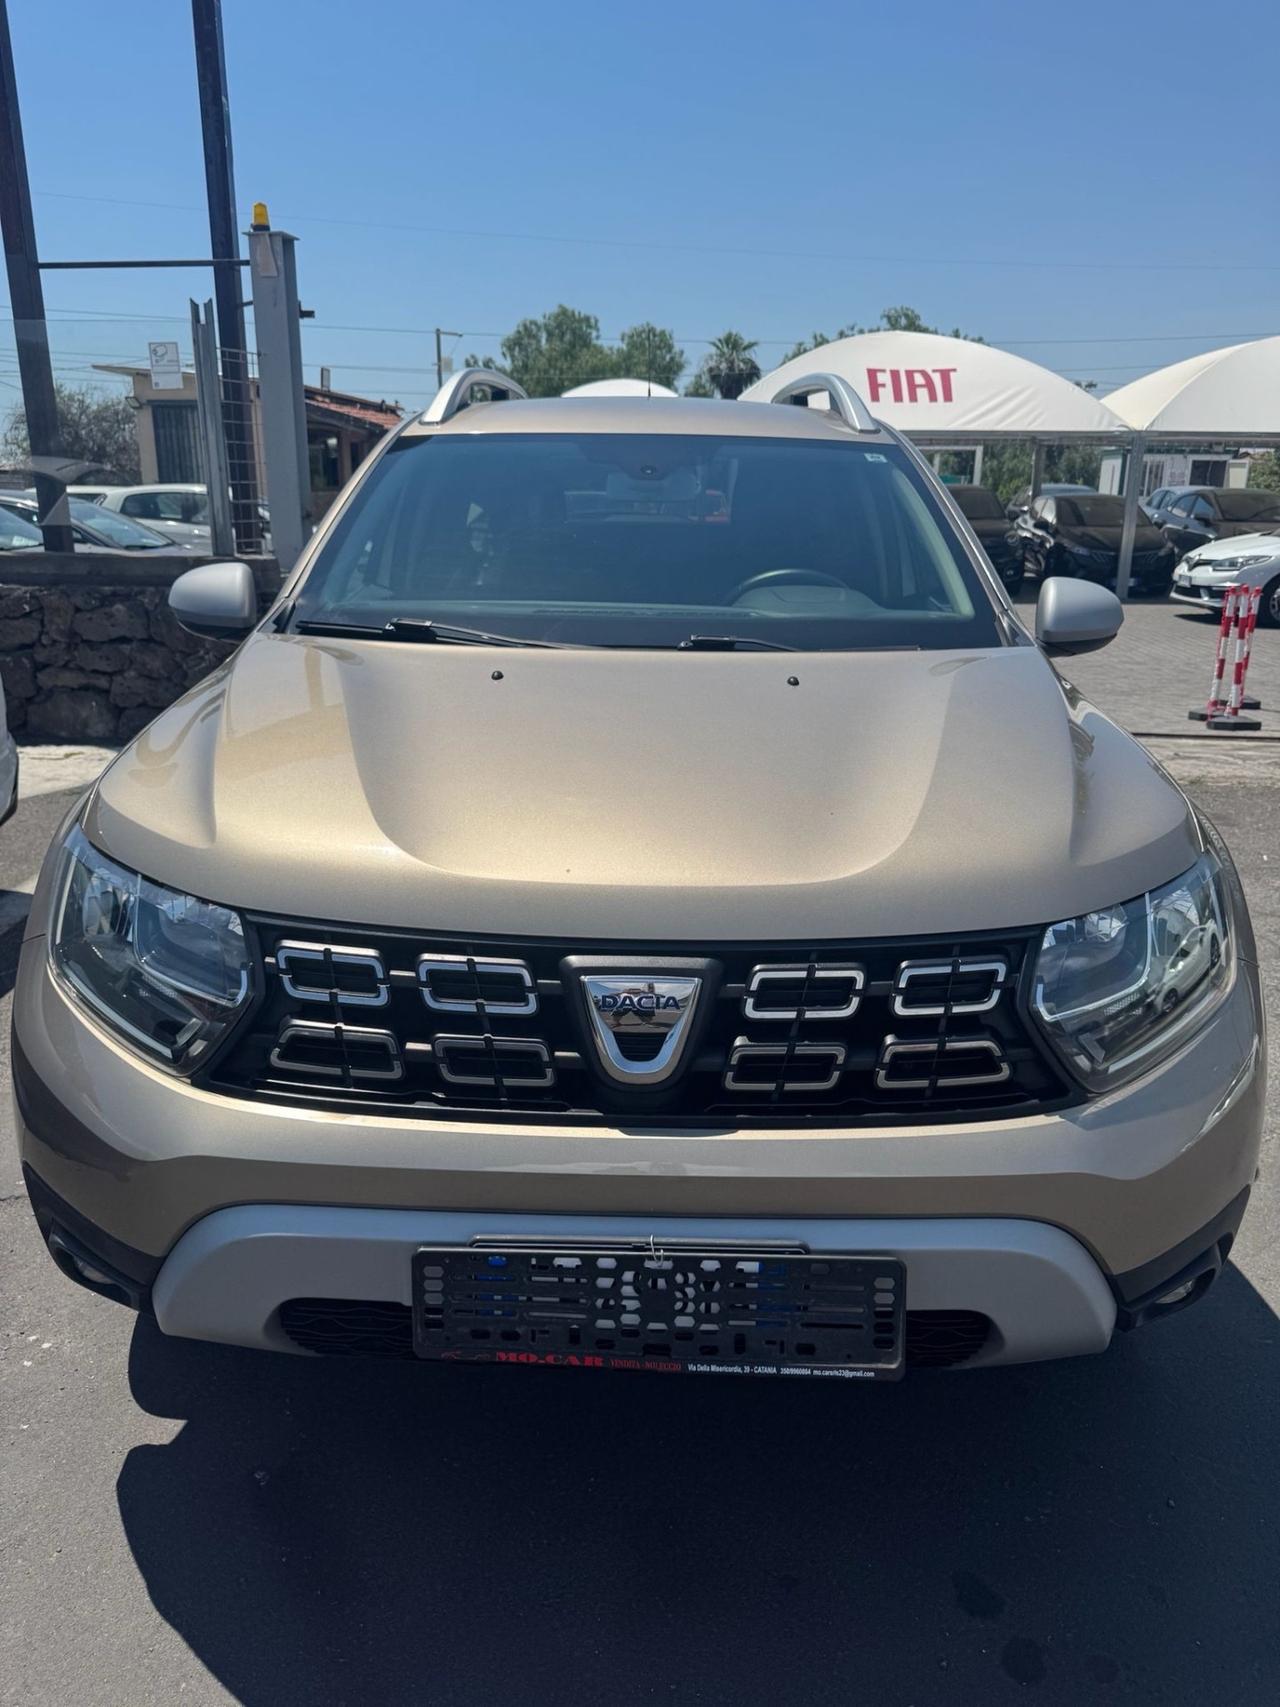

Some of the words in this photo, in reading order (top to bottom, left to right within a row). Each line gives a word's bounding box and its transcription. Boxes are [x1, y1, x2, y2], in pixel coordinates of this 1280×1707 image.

[866, 368, 957, 403] FIAT
[601, 994, 681, 1010] DACIA
[496, 1351, 604, 1367] MO-CAR
[687, 1363, 696, 1372] Via
[754, 1365, 777, 1374] CATANIA
